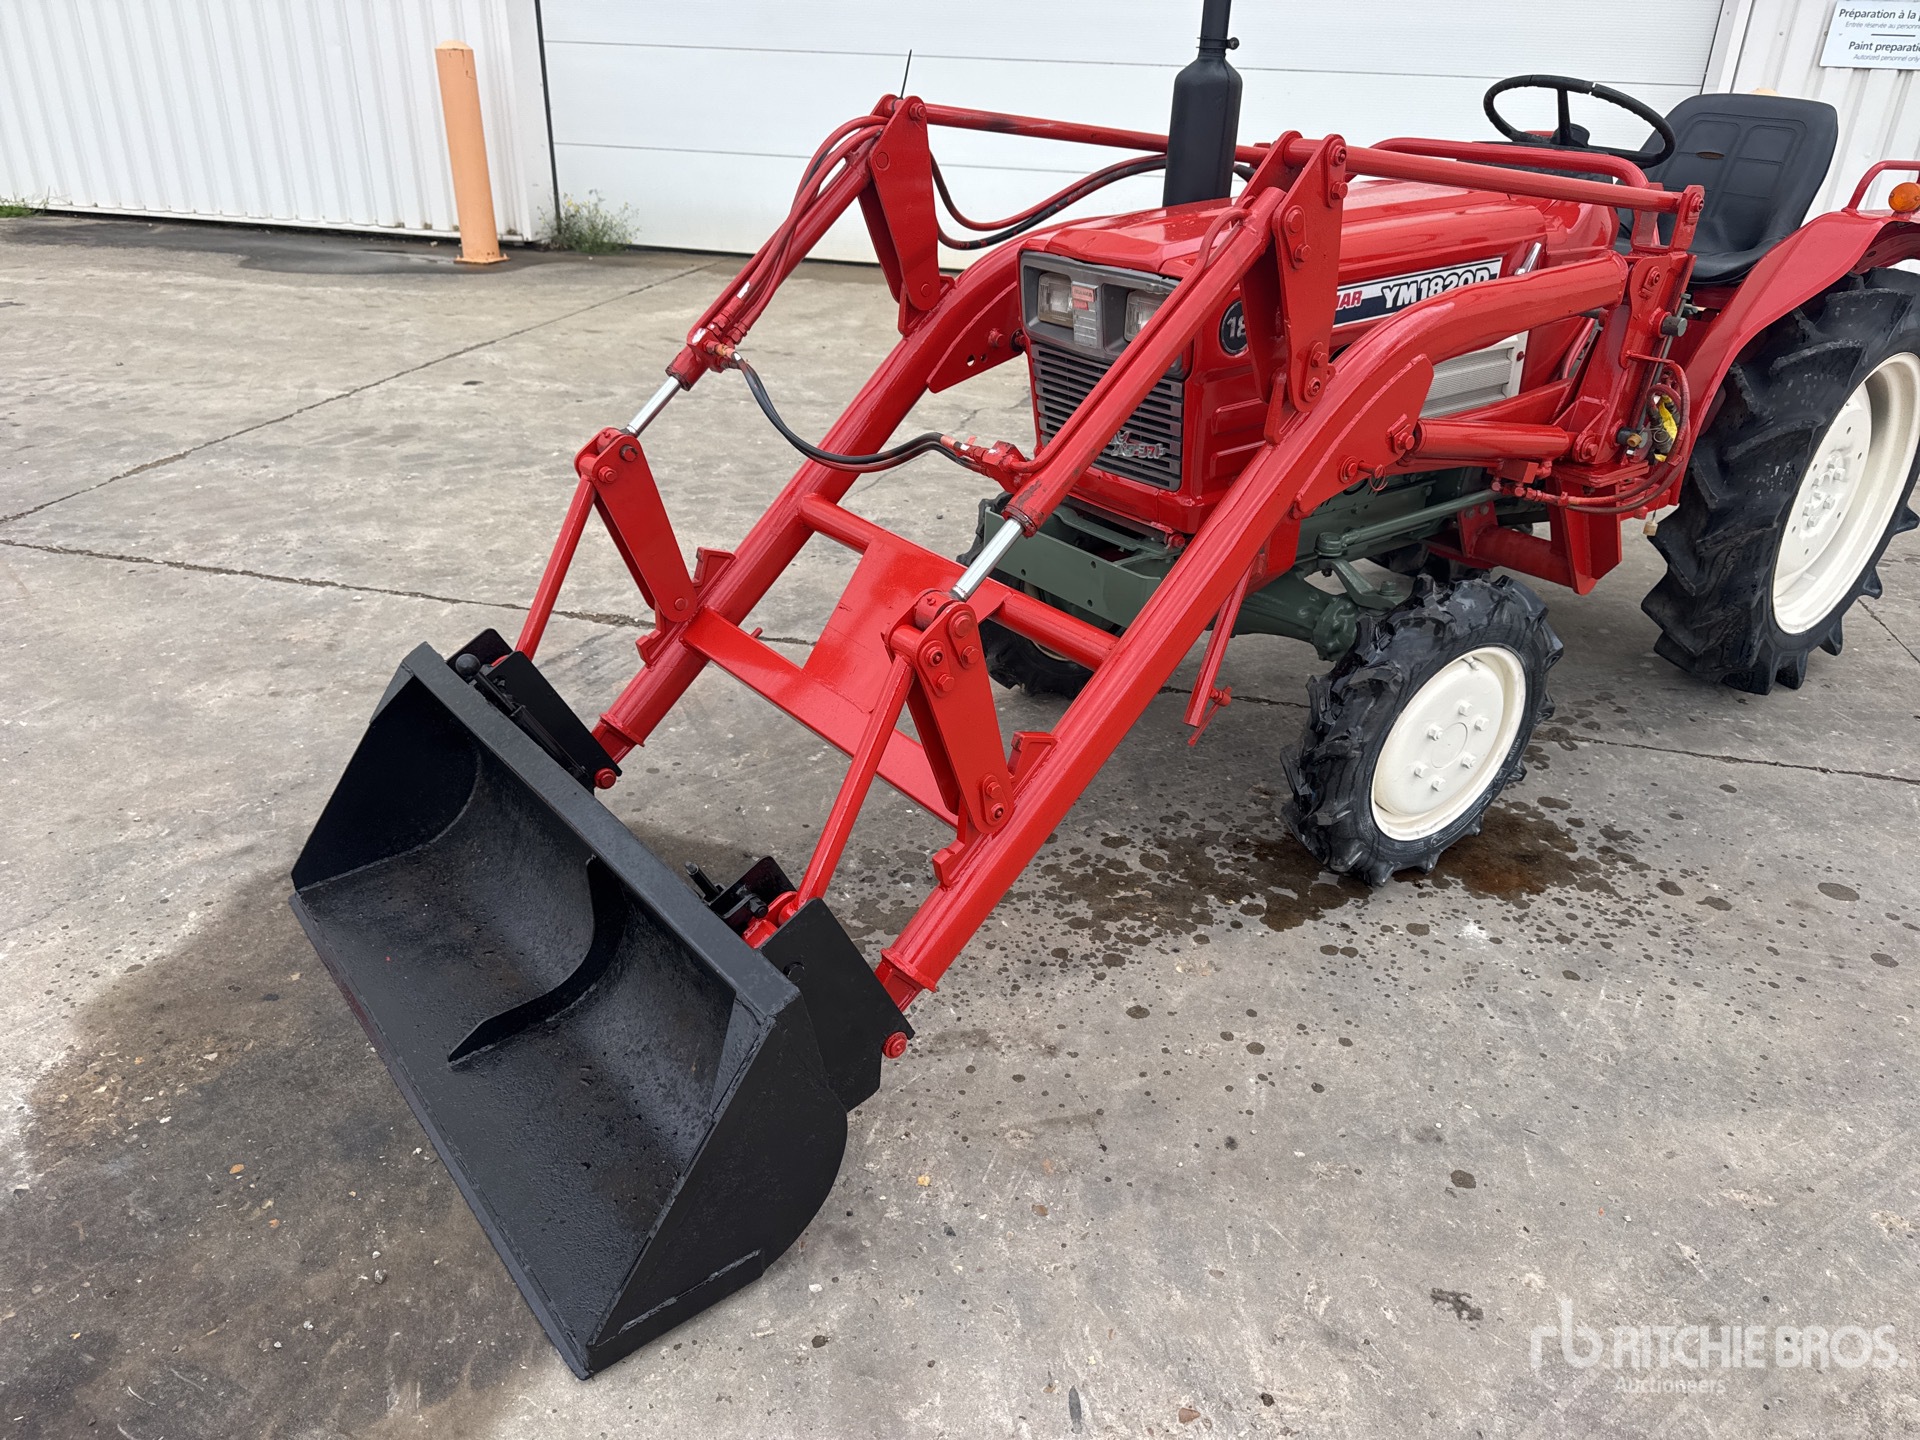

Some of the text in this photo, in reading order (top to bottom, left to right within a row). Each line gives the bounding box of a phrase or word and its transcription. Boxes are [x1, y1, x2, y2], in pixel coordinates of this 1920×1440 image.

[1839, 8, 1896, 20] Préparation
[1898, 9, 1905, 19] à
[1907, 9, 1917, 19] la
[1848, 41, 1873, 50] Paint
[1908, 55, 1920, 63] only
